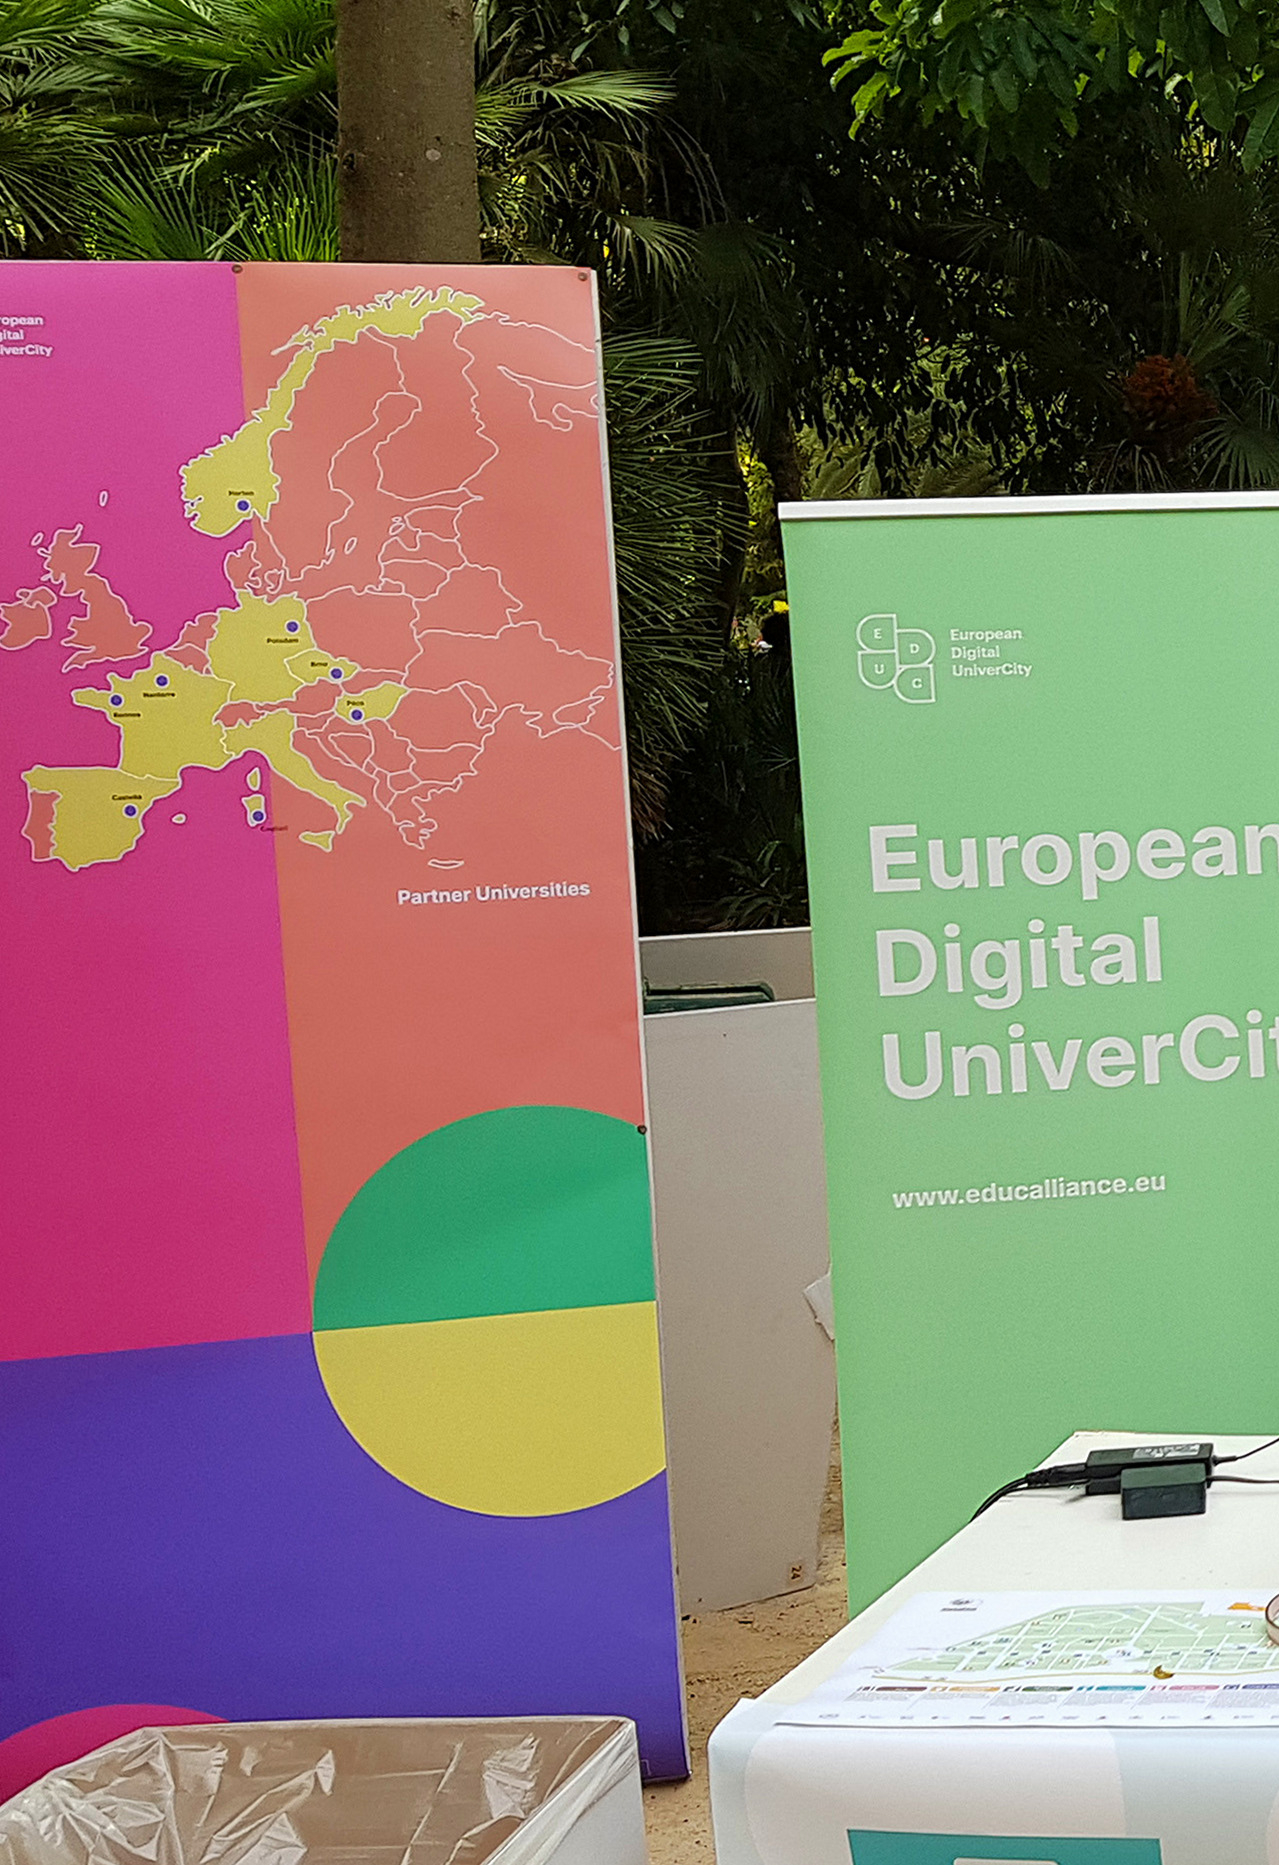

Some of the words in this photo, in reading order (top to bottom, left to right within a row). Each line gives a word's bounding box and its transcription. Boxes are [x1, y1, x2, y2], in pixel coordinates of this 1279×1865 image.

[950, 629, 1022, 642] European
[951, 645, 1000, 661] Digital
[952, 662, 1032, 677] UniverCity
[397, 886, 471, 906] Partner
[474, 879, 591, 902] Universities
[876, 916, 1162, 1011] Digital
[892, 1173, 1167, 1210] www.educalliance.eu
